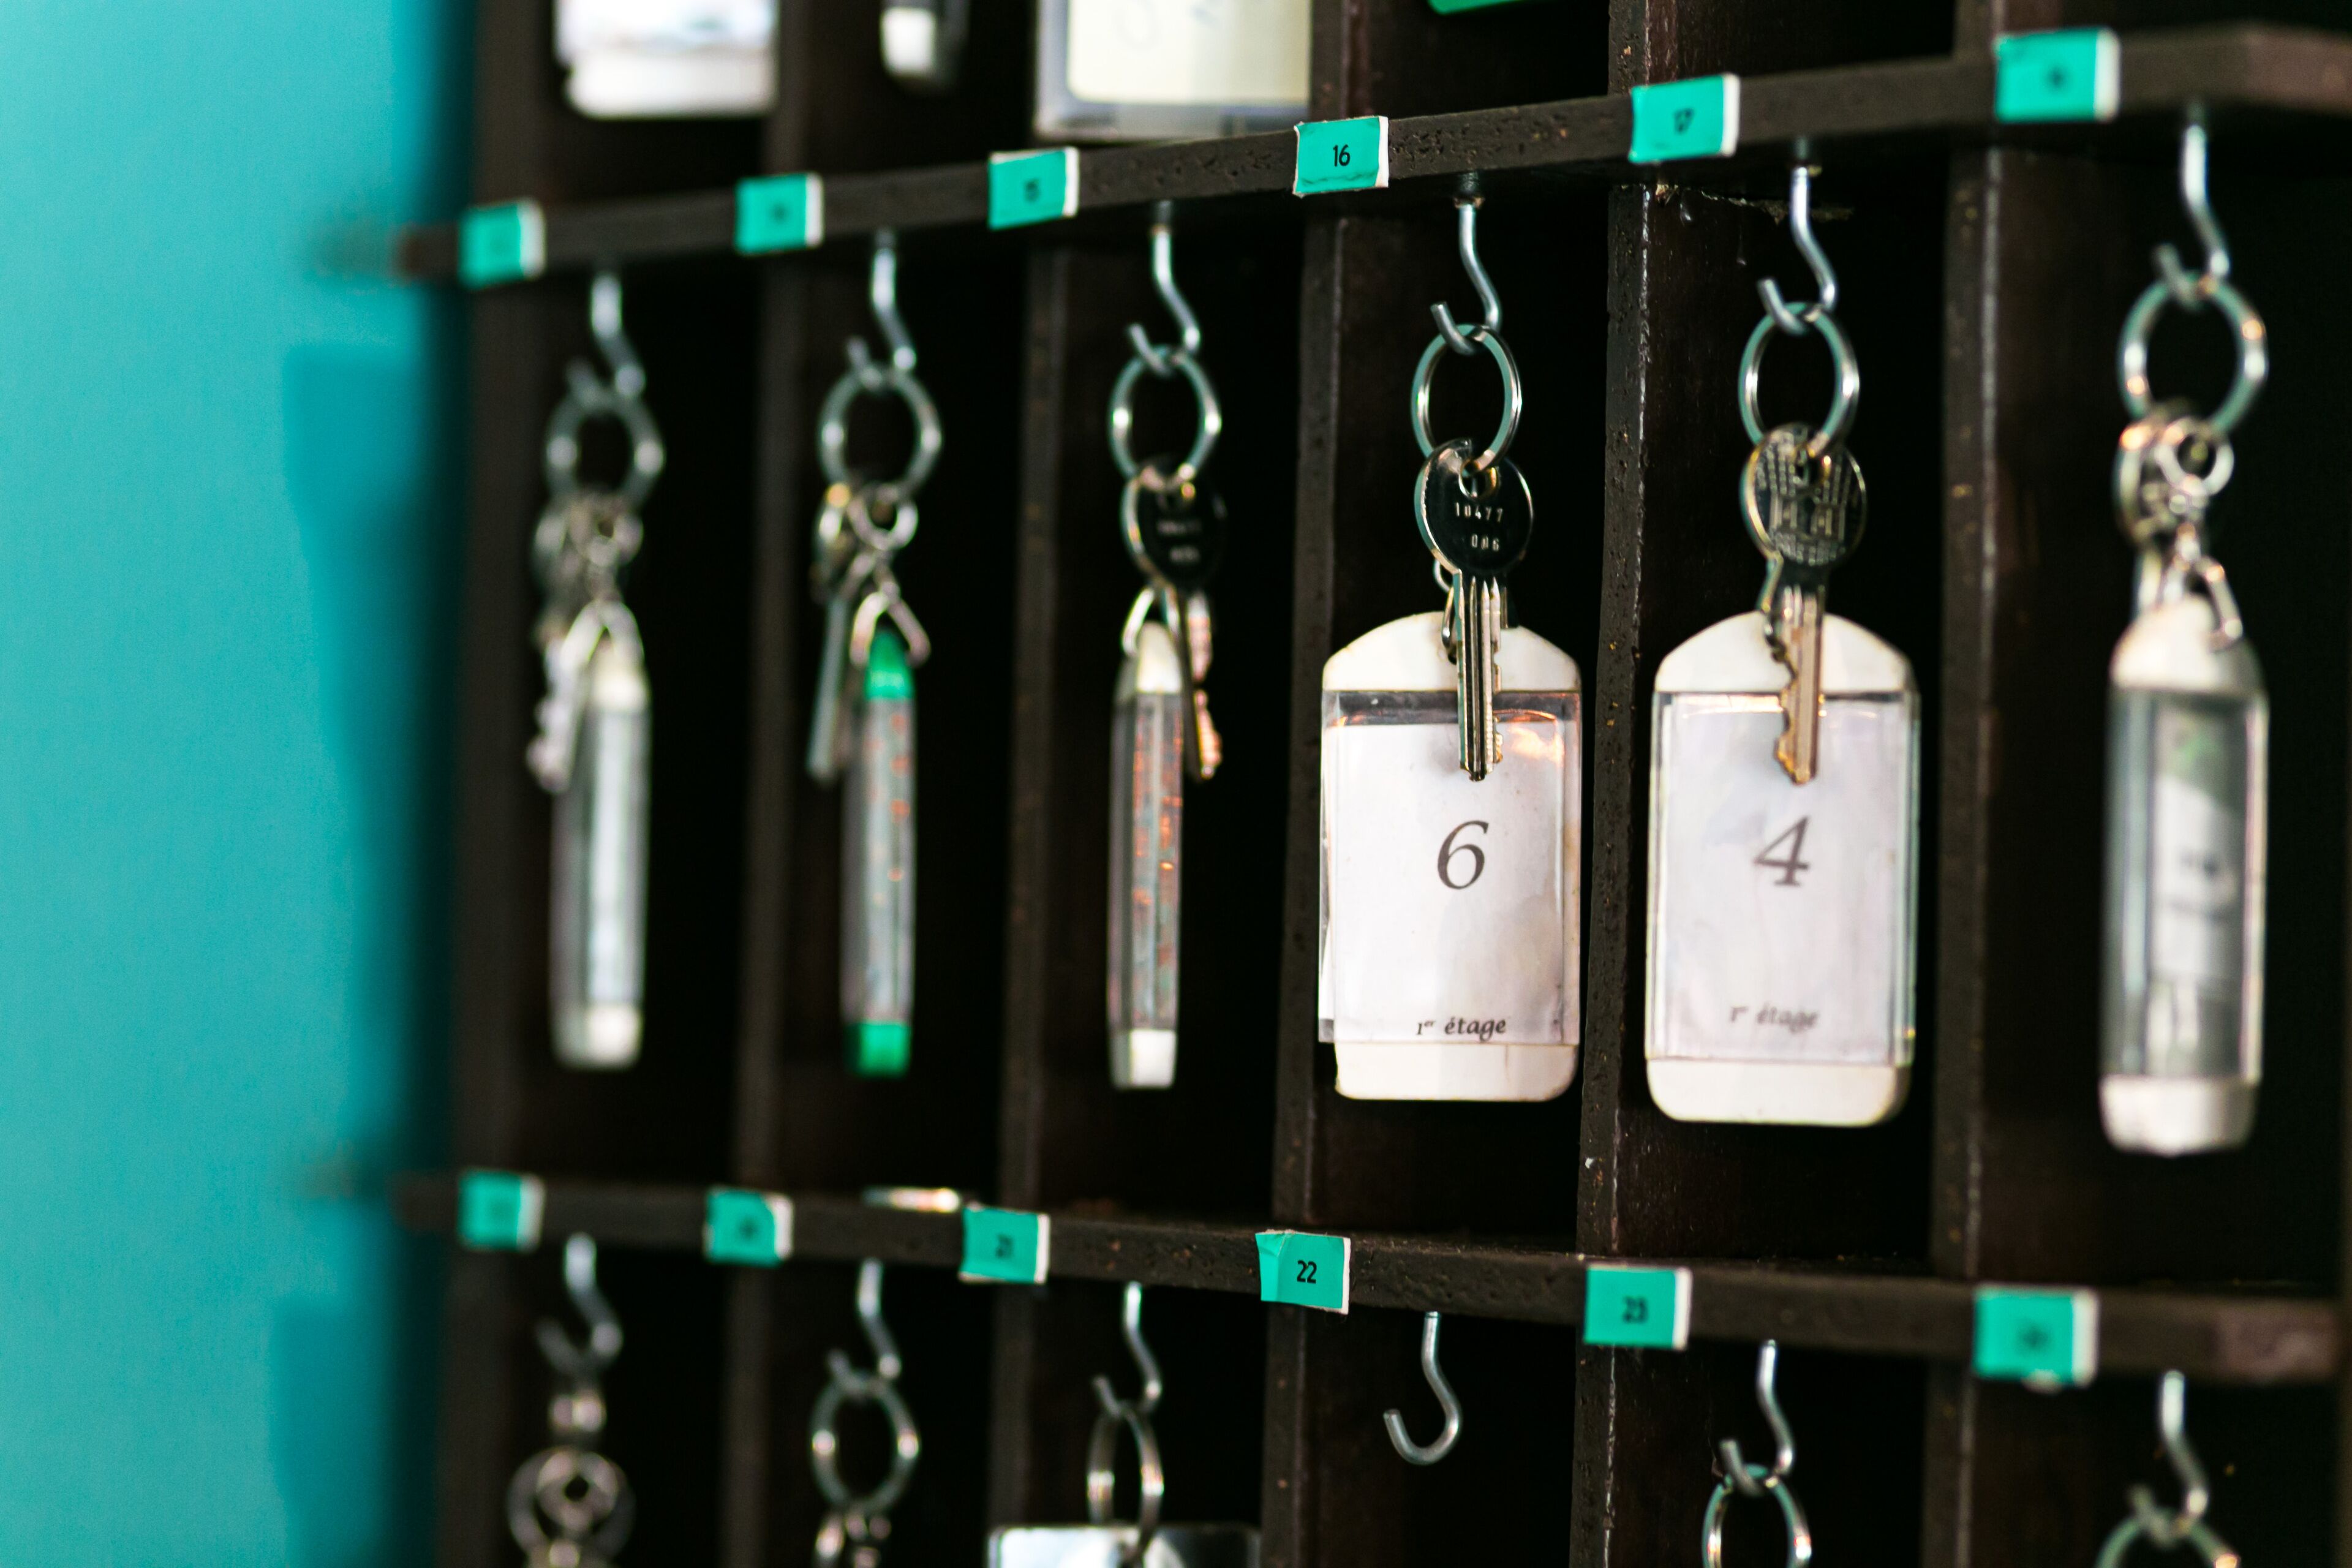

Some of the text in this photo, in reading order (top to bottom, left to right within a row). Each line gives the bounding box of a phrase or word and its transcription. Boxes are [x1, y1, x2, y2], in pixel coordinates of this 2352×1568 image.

[1332, 144, 1351, 167] 16
[1437, 820, 1489, 889] 6
[1753, 815, 1811, 887] 4
[1444, 1016, 1507, 1042] étage
[1756, 1000, 1820, 1035] étage
[1296, 1259, 1317, 1284] 22
